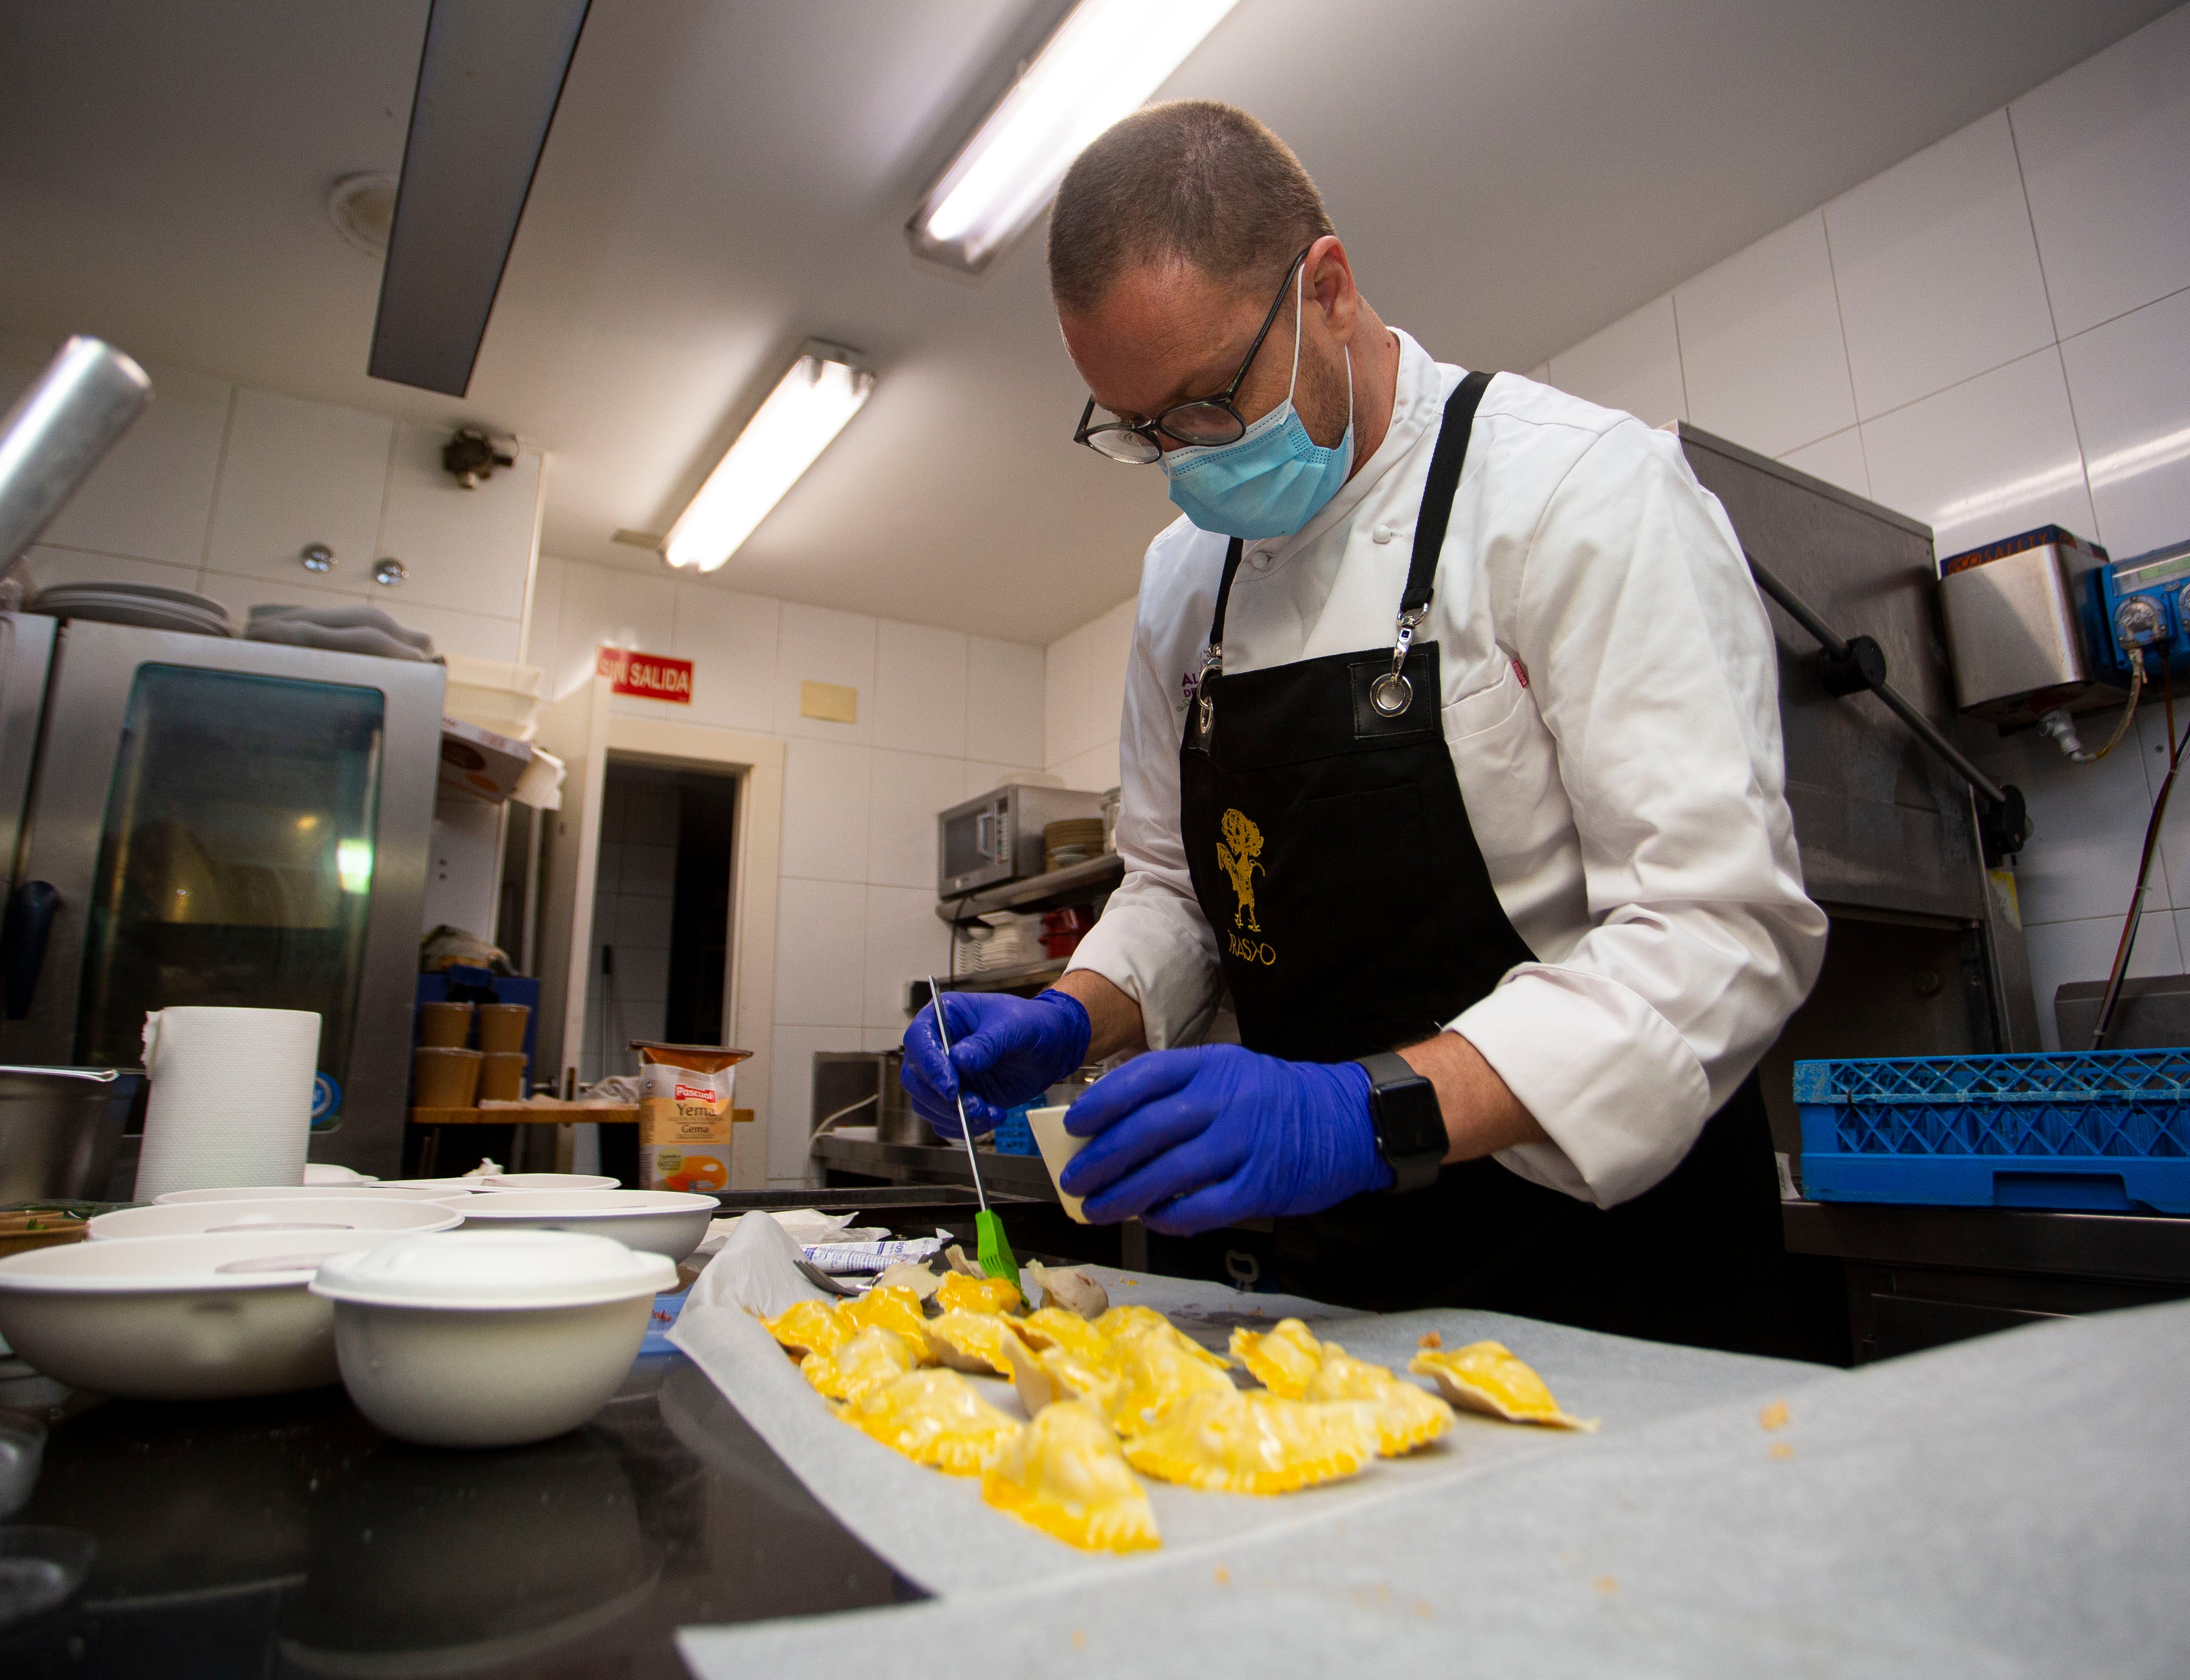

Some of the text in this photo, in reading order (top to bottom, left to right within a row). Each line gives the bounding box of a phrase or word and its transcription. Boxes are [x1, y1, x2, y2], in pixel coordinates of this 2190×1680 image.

[630, 663, 689, 694] SALIDA
[1182, 672, 1200, 687] AL
[676, 1086, 713, 1100] Pascual
[677, 1103, 716, 1117] Yema
[681, 1124, 709, 1133] Gema
